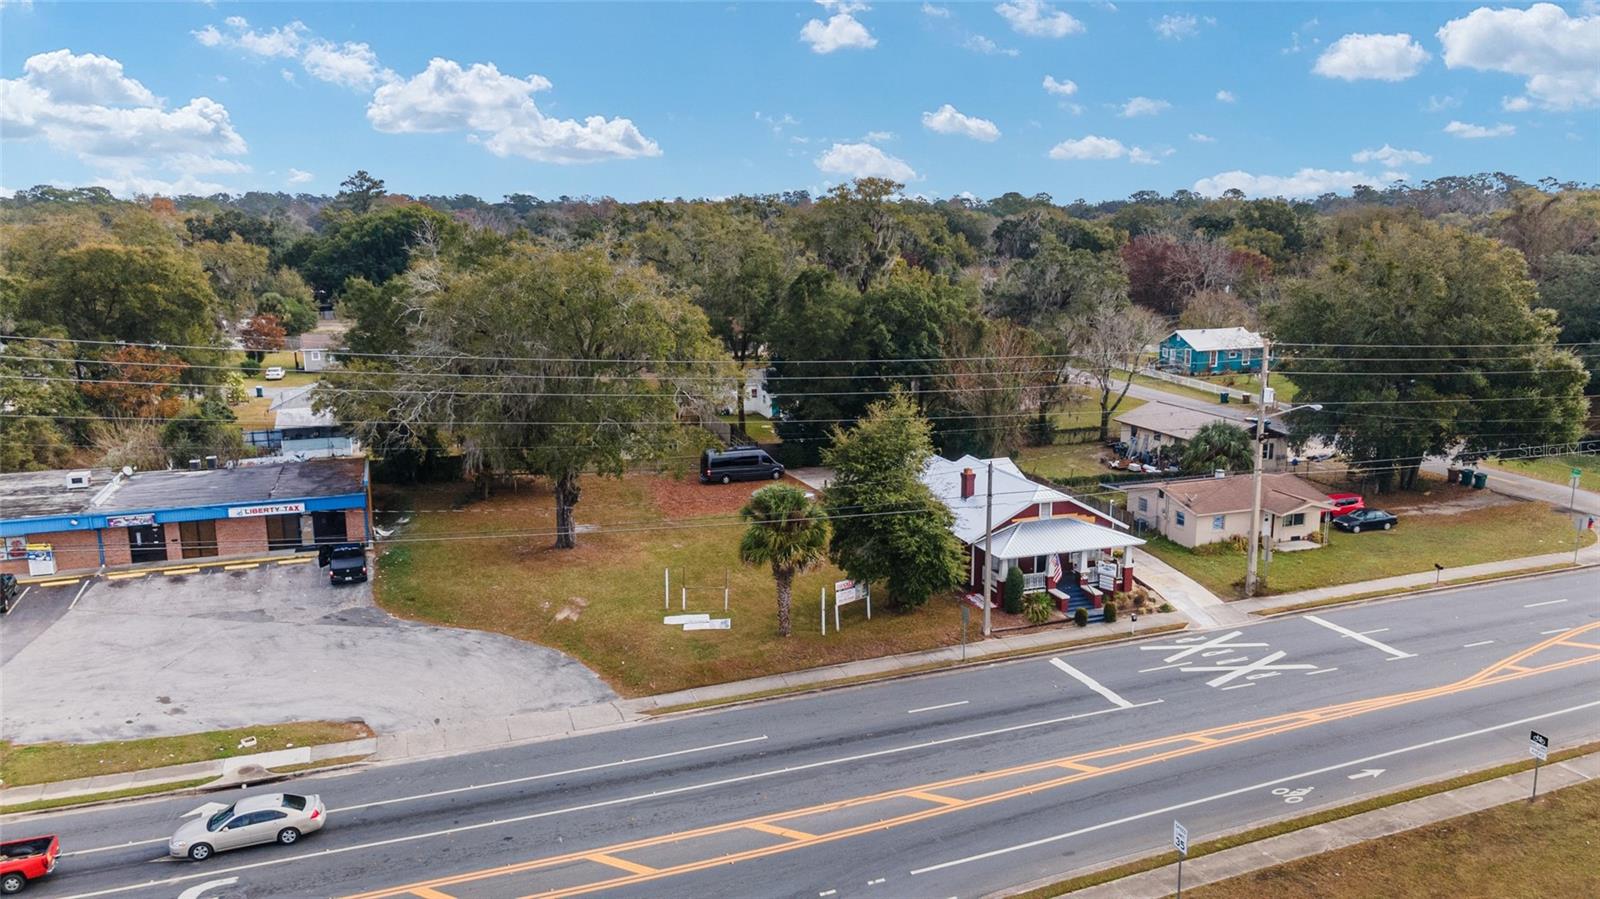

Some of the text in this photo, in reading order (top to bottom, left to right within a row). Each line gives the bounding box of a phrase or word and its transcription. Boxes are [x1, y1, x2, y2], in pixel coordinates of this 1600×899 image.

[244, 504, 300, 515] LIBERTY TAX
[1175, 837, 1185, 850] 35
